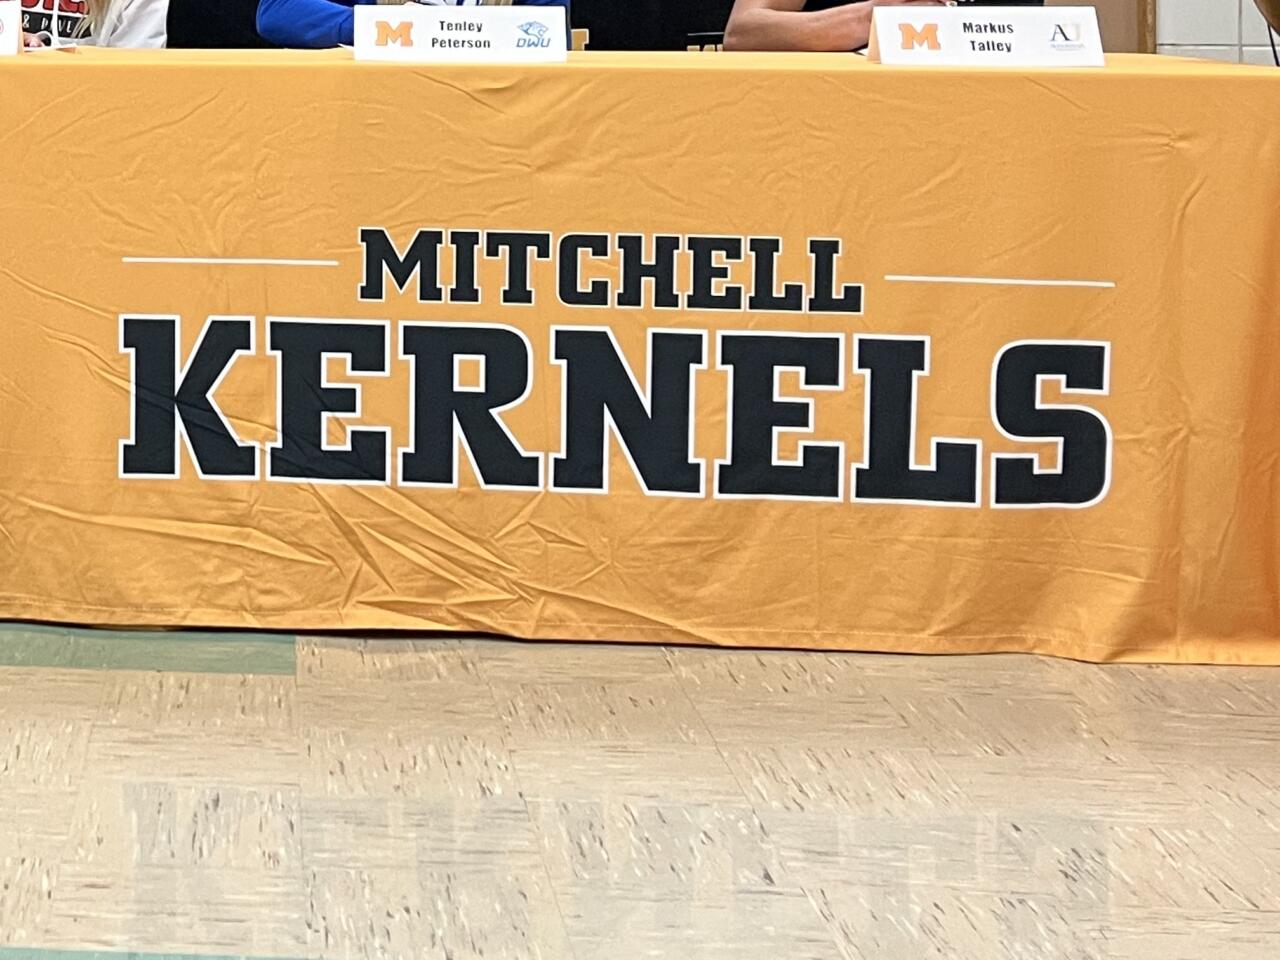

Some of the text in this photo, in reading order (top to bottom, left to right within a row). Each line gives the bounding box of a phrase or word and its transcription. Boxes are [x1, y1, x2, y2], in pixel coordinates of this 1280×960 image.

[438, 20, 483, 33] Tenley
[963, 21, 1014, 34] Markus
[374, 20, 414, 47] M
[898, 22, 942, 50] M
[431, 38, 491, 49] Peterson
[515, 37, 551, 49] DWU
[969, 40, 1013, 53] Talley
[357, 226, 863, 314] MITCHELL
[118, 312, 1114, 511] KERNELS
